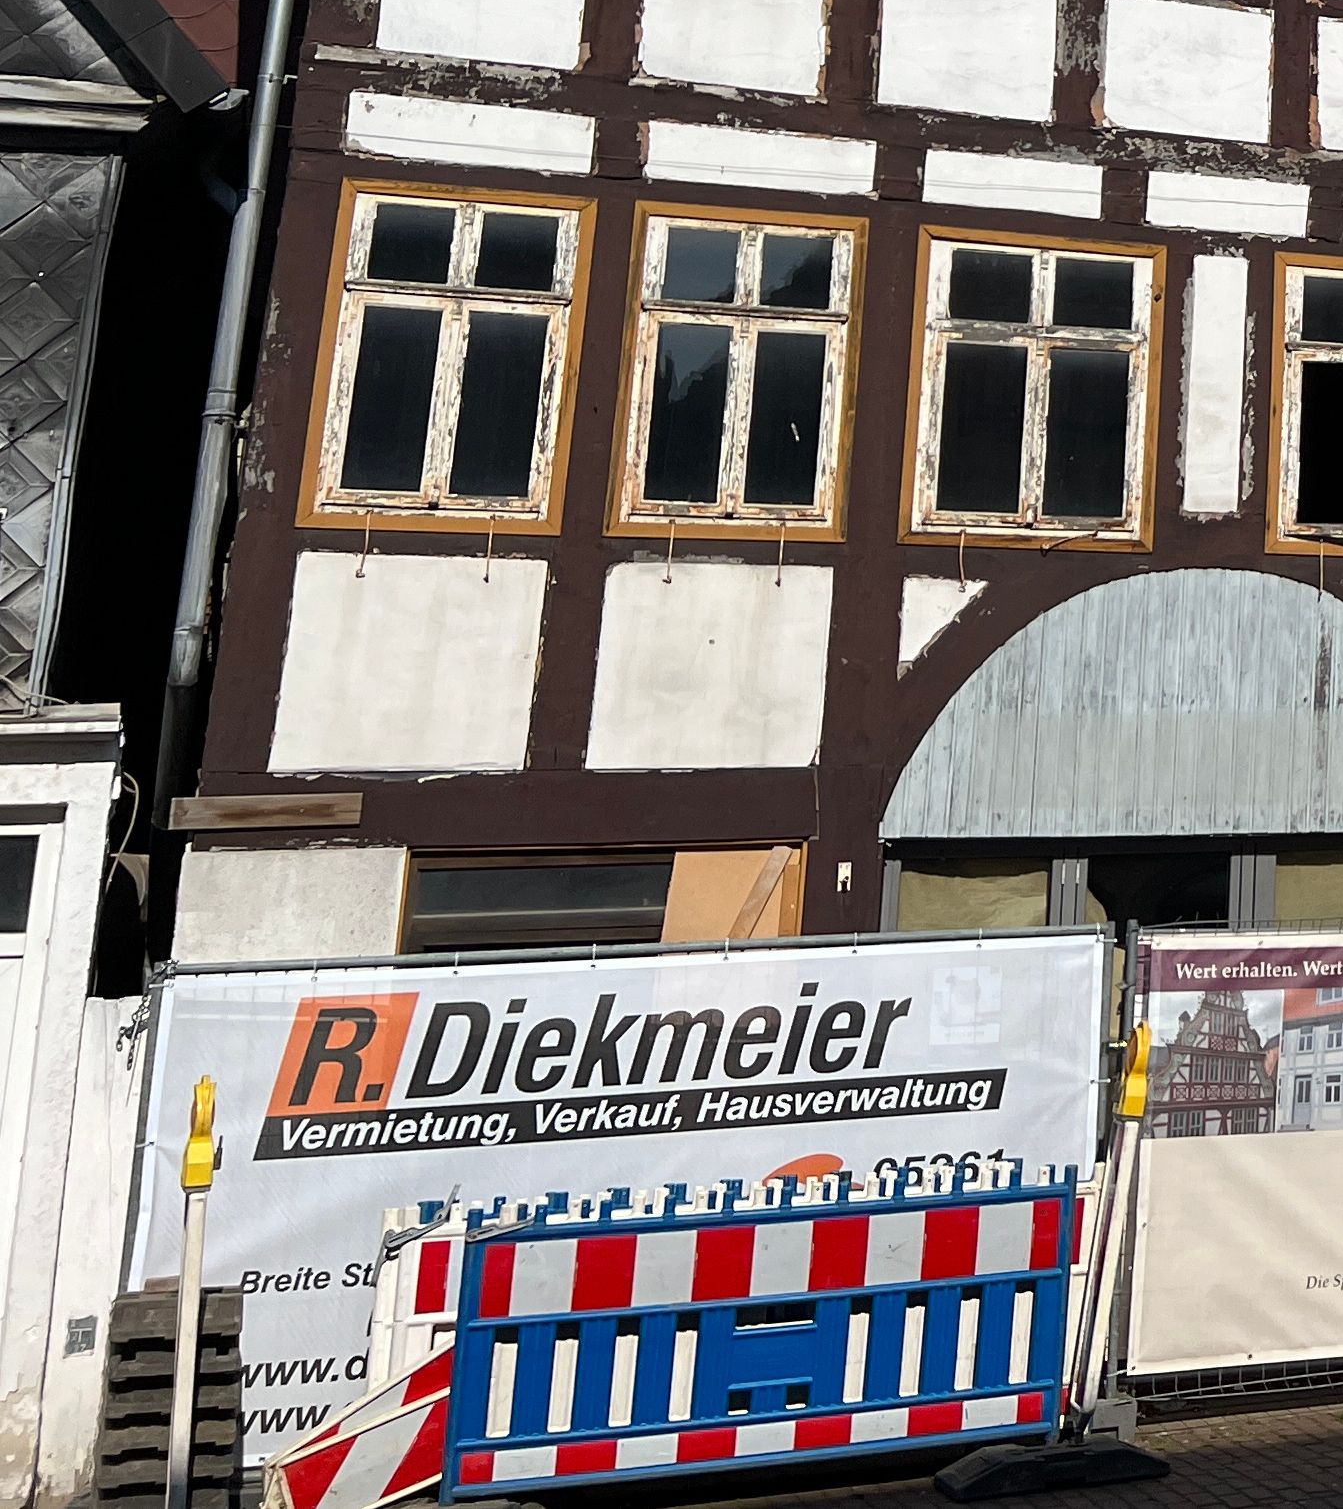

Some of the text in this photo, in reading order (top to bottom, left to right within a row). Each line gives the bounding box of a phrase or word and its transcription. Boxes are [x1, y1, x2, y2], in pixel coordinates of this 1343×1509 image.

[1176, 963, 1217, 979] Wert
[1221, 962, 1298, 978] erhalten.
[1303, 960, 1342, 976] Wert
[288, 981, 912, 1107] R. Diekmeier
[281, 1079, 993, 1151] Vermietung, Verkauf, Hausverwaltung
[240, 1262, 377, 1294] Breite St
[1306, 1275, 1330, 1290] Die
